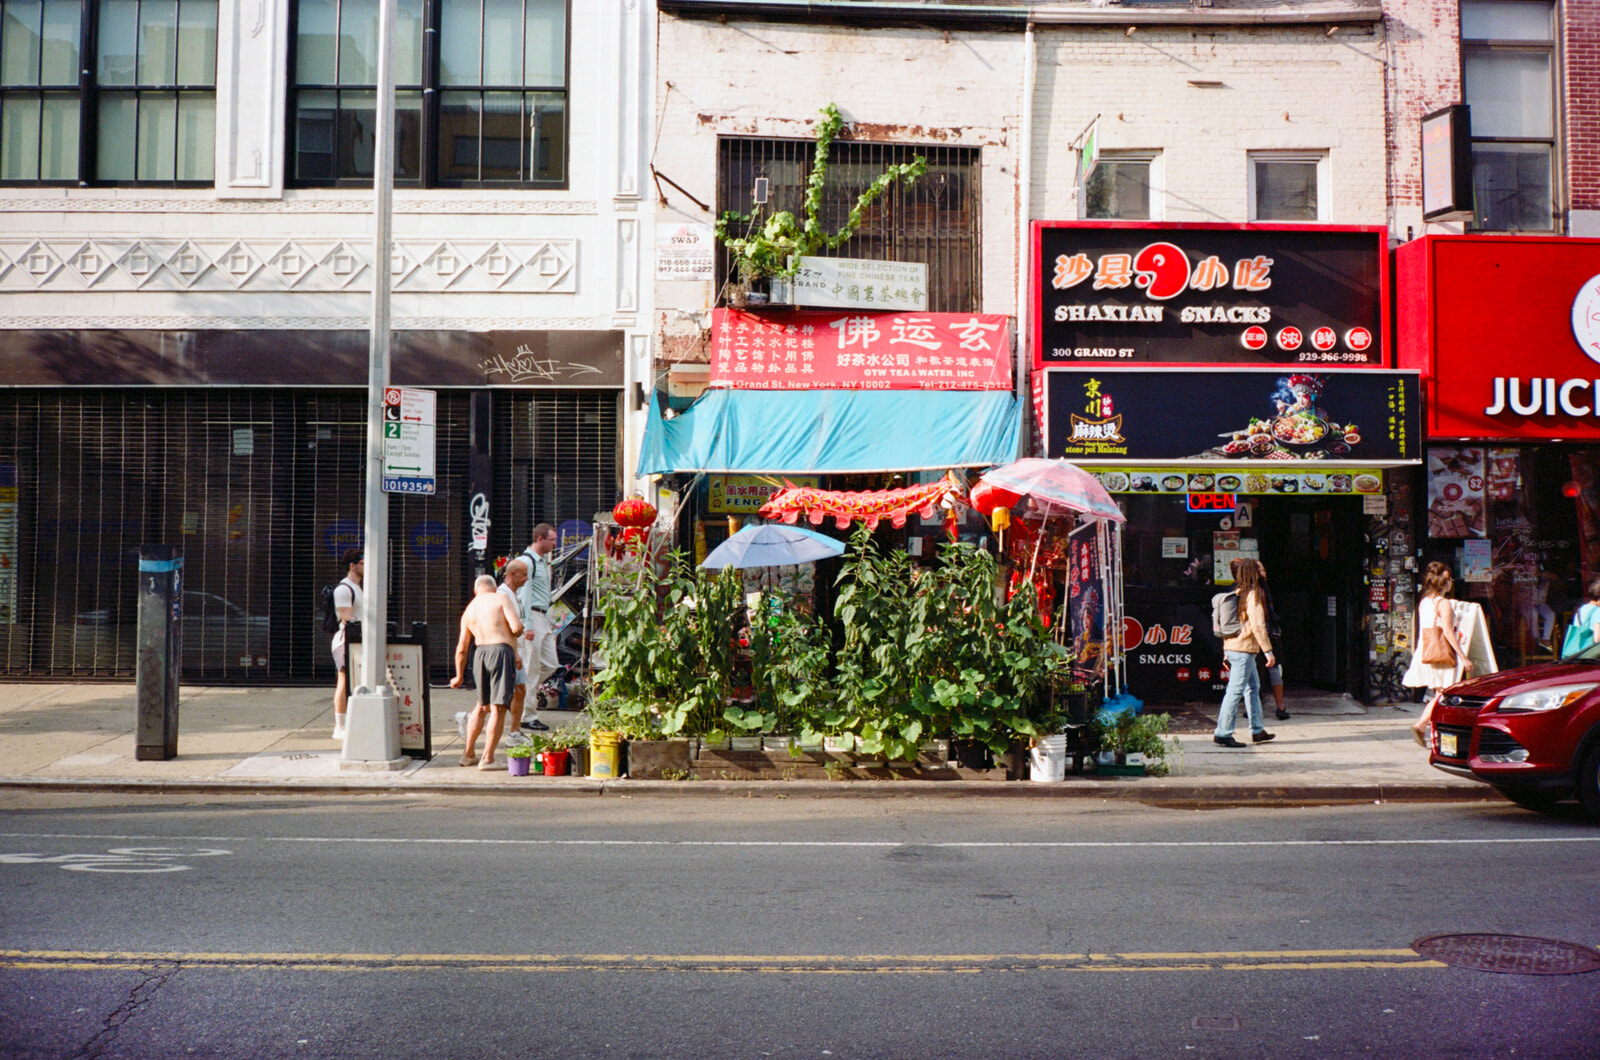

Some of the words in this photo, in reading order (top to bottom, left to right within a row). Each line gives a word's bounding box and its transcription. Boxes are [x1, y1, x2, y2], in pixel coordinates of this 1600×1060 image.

[838, 262, 858, 270] WIDE
[861, 263, 907, 273] SELECTION
[1051, 253, 1133, 290] 沙县
[1190, 255, 1274, 291] 小吃
[838, 271, 857, 279] FINE
[860, 272, 896, 281] CHINESE
[900, 275, 920, 283] TEAS
[1054, 305, 1164, 322] SHAXIAN
[1180, 306, 1271, 323] SNACKS
[1281, 331, 1300, 345] 浓
[1316, 331, 1335, 346] 鲜
[1350, 331, 1369, 346] 香
[836, 353, 910, 367] 好茶水公司
[1052, 348, 1072, 357] 300
[1074, 348, 1117, 358] GRAND
[1118, 348, 1135, 358] ST
[1299, 352, 1368, 362] 929-966-9998
[864, 369, 887, 377] GTW
[736, 379, 769, 389] Grand
[788, 380, 811, 389] New
[842, 381, 858, 389] NY
[860, 381, 891, 389] 10002
[1485, 377, 1600, 416] JUIC
[388, 423, 398, 438] 2
[726, 498, 761, 506] FENG
[1189, 494, 1235, 509] OPEN
[1238, 505, 1249, 520] A
[1144, 624, 1193, 645] 小吃
[1139, 654, 1192, 664] SNACKS
